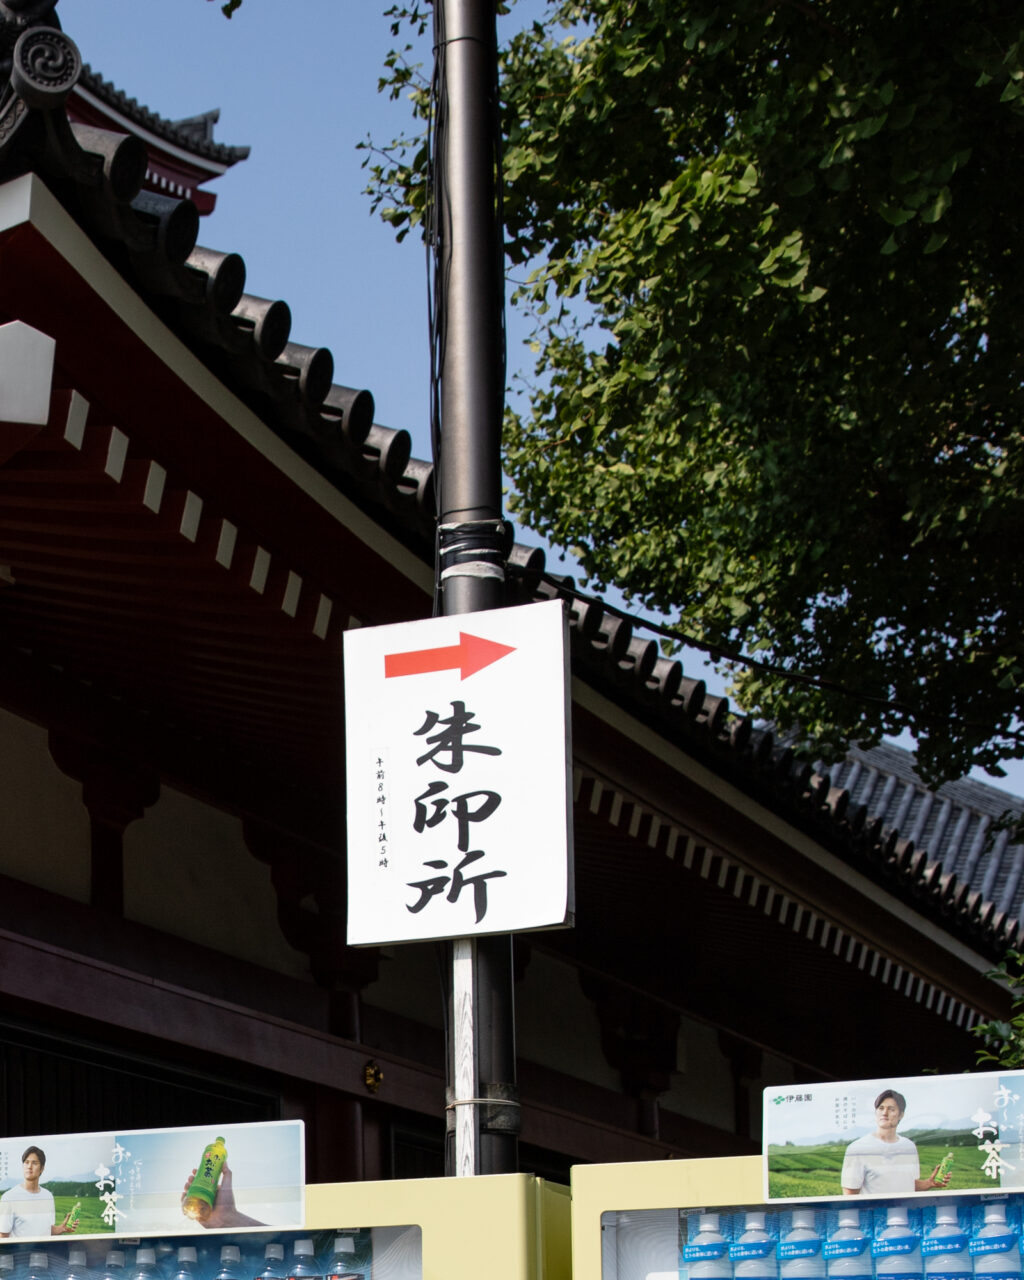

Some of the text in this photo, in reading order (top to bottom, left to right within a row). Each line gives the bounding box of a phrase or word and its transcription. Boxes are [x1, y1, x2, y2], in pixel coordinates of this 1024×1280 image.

[406, 700, 507, 924] 朱印所
[971, 1107, 1016, 1180] お茶
[94, 1163, 126, 1226] お茶
